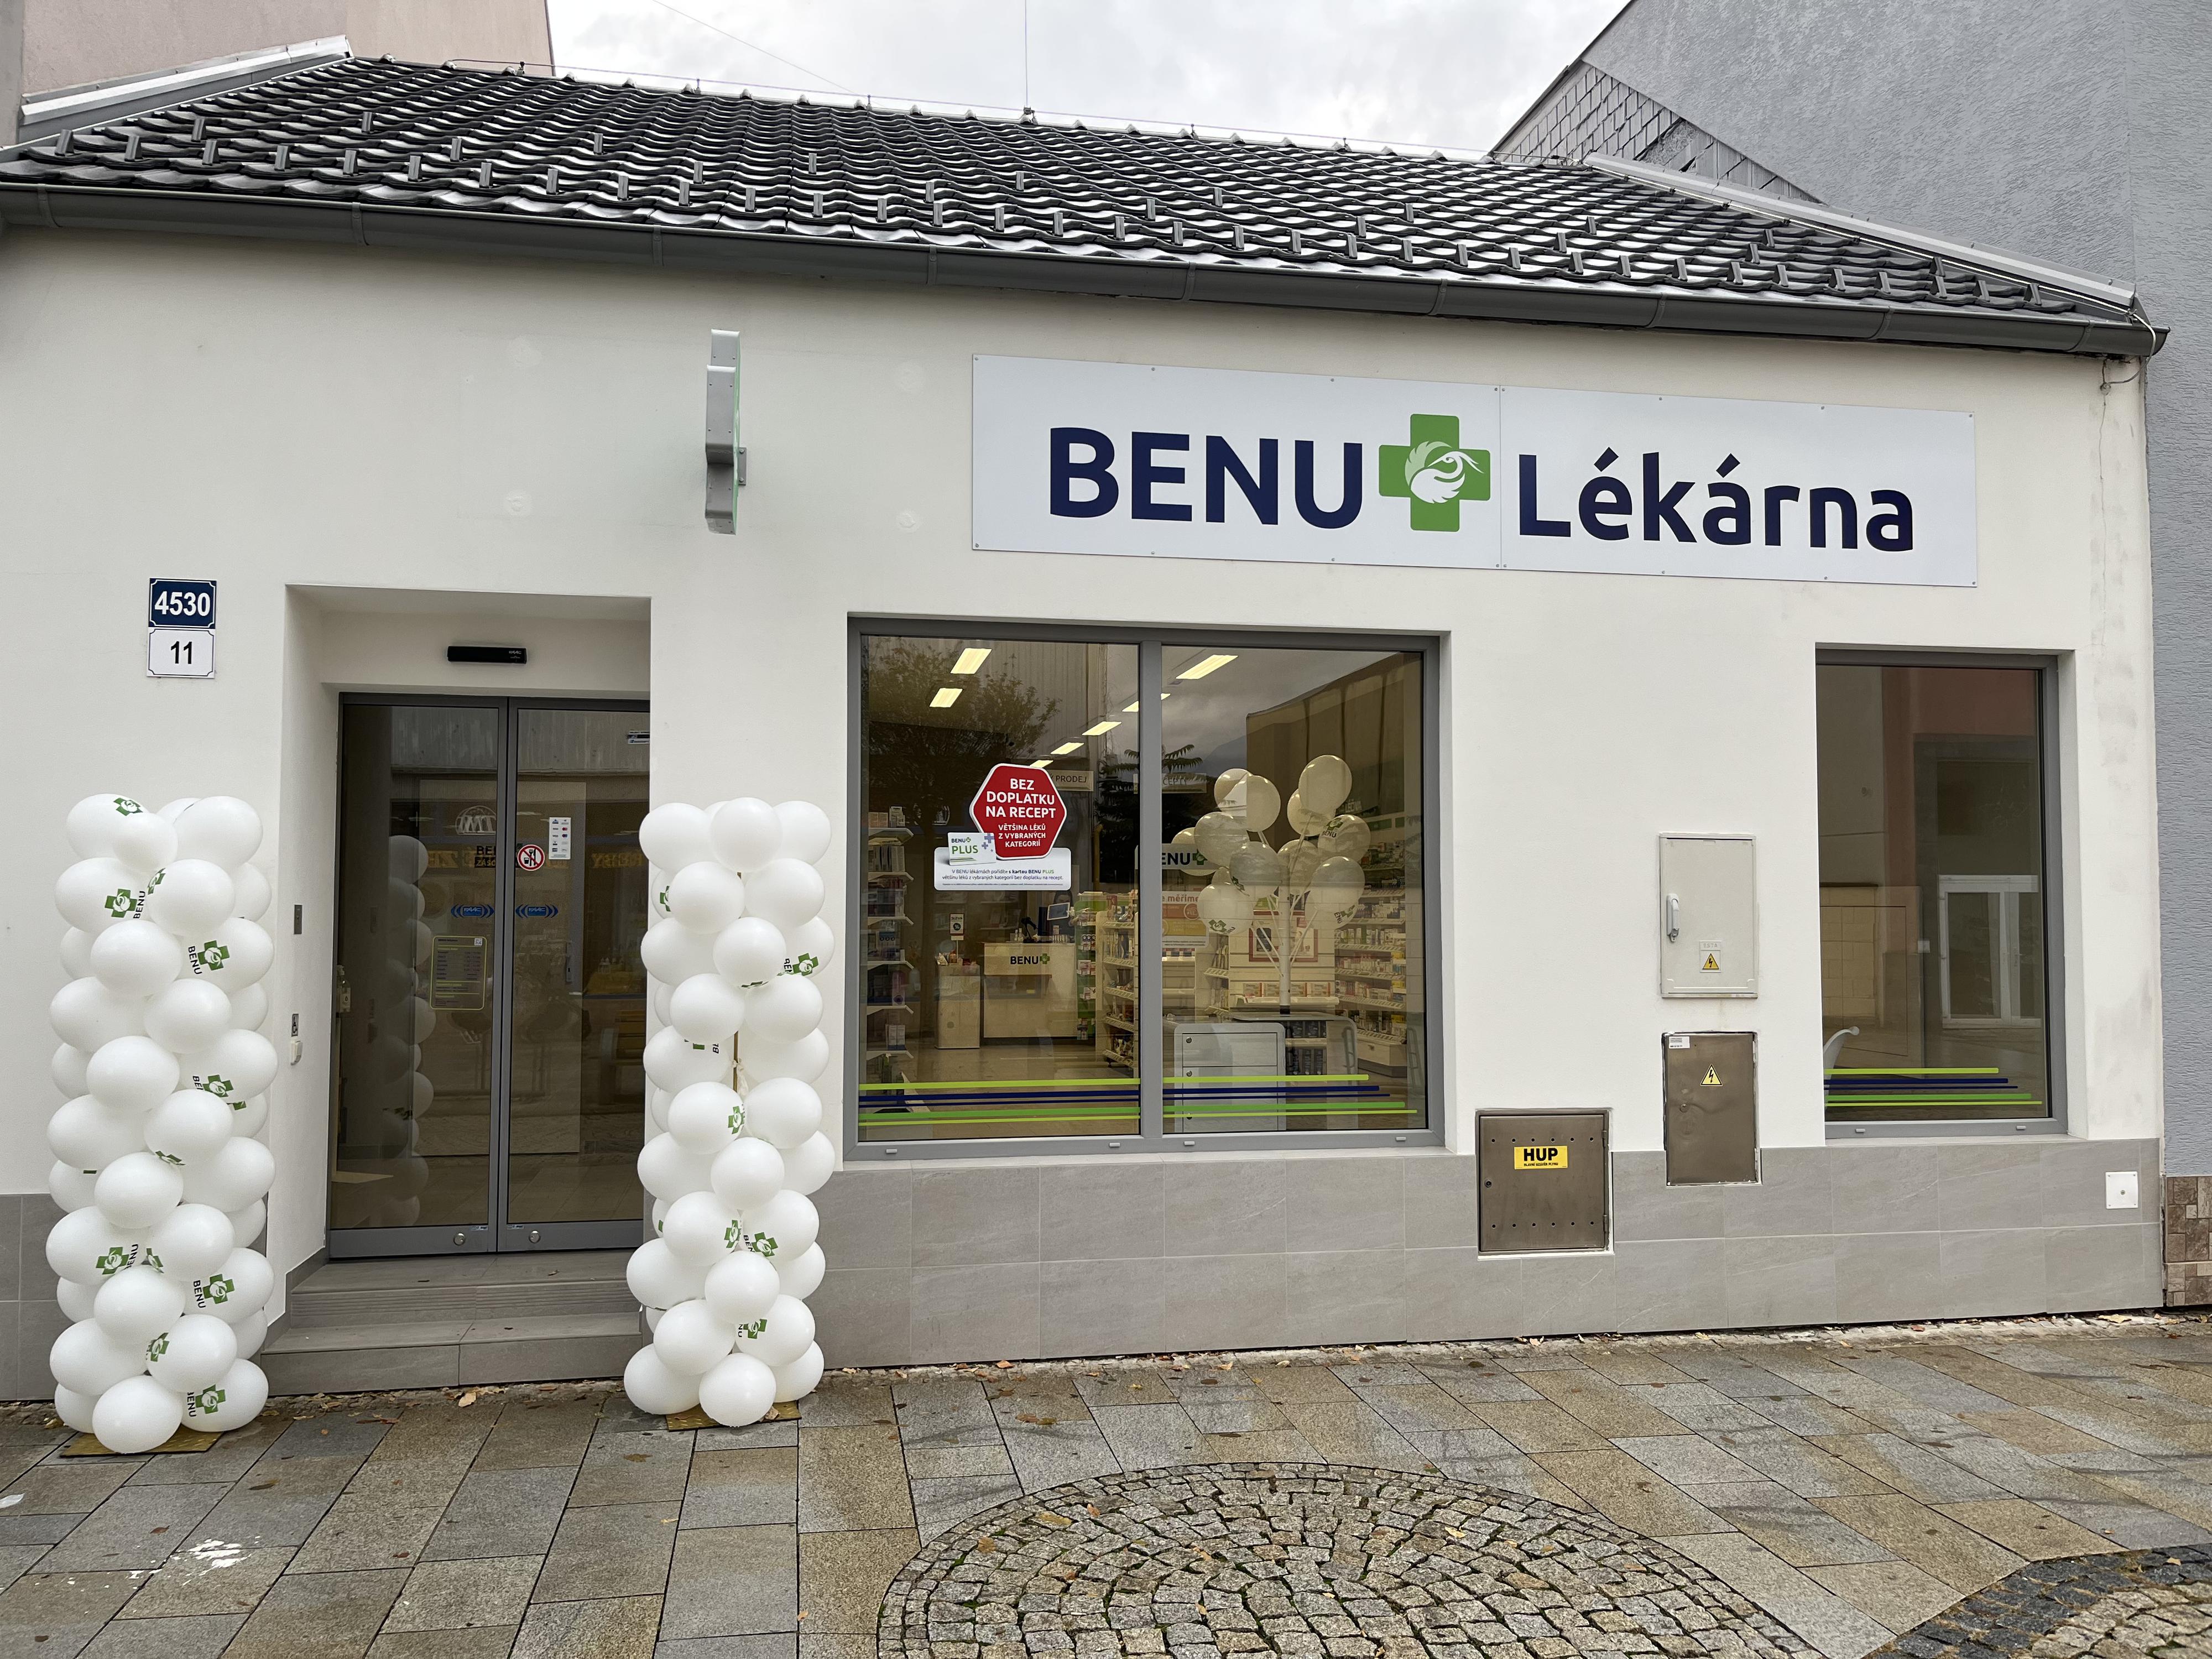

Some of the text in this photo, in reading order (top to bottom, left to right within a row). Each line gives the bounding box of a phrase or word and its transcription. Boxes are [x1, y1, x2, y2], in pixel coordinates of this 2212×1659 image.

[1050, 427, 1913, 552] BENU Lékárna
[154, 591, 211, 617] 4530
[170, 641, 192, 665] 11
[1010, 778, 1035, 790] BEZ
[1162, 778, 1187, 786] CEPTY
[987, 791, 1055, 805] DOPLATKU
[986, 806, 1056, 818] NA RECEPT
[952, 845, 978, 854] PLUS
[1005, 839, 1040, 847] KATEGORIÍ
[477, 846, 496, 855] BE
[1162, 852, 1191, 865] ENU
[133, 890, 146, 919] BENU
[1334, 911, 1343, 924] ENU
[188, 946, 203, 975] BENU
[1011, 956, 1039, 964] BENU
[1524, 1147, 1558, 1161] HUP
[743, 1235, 755, 1253] BEN
[193, 1280, 206, 1308] BENU
